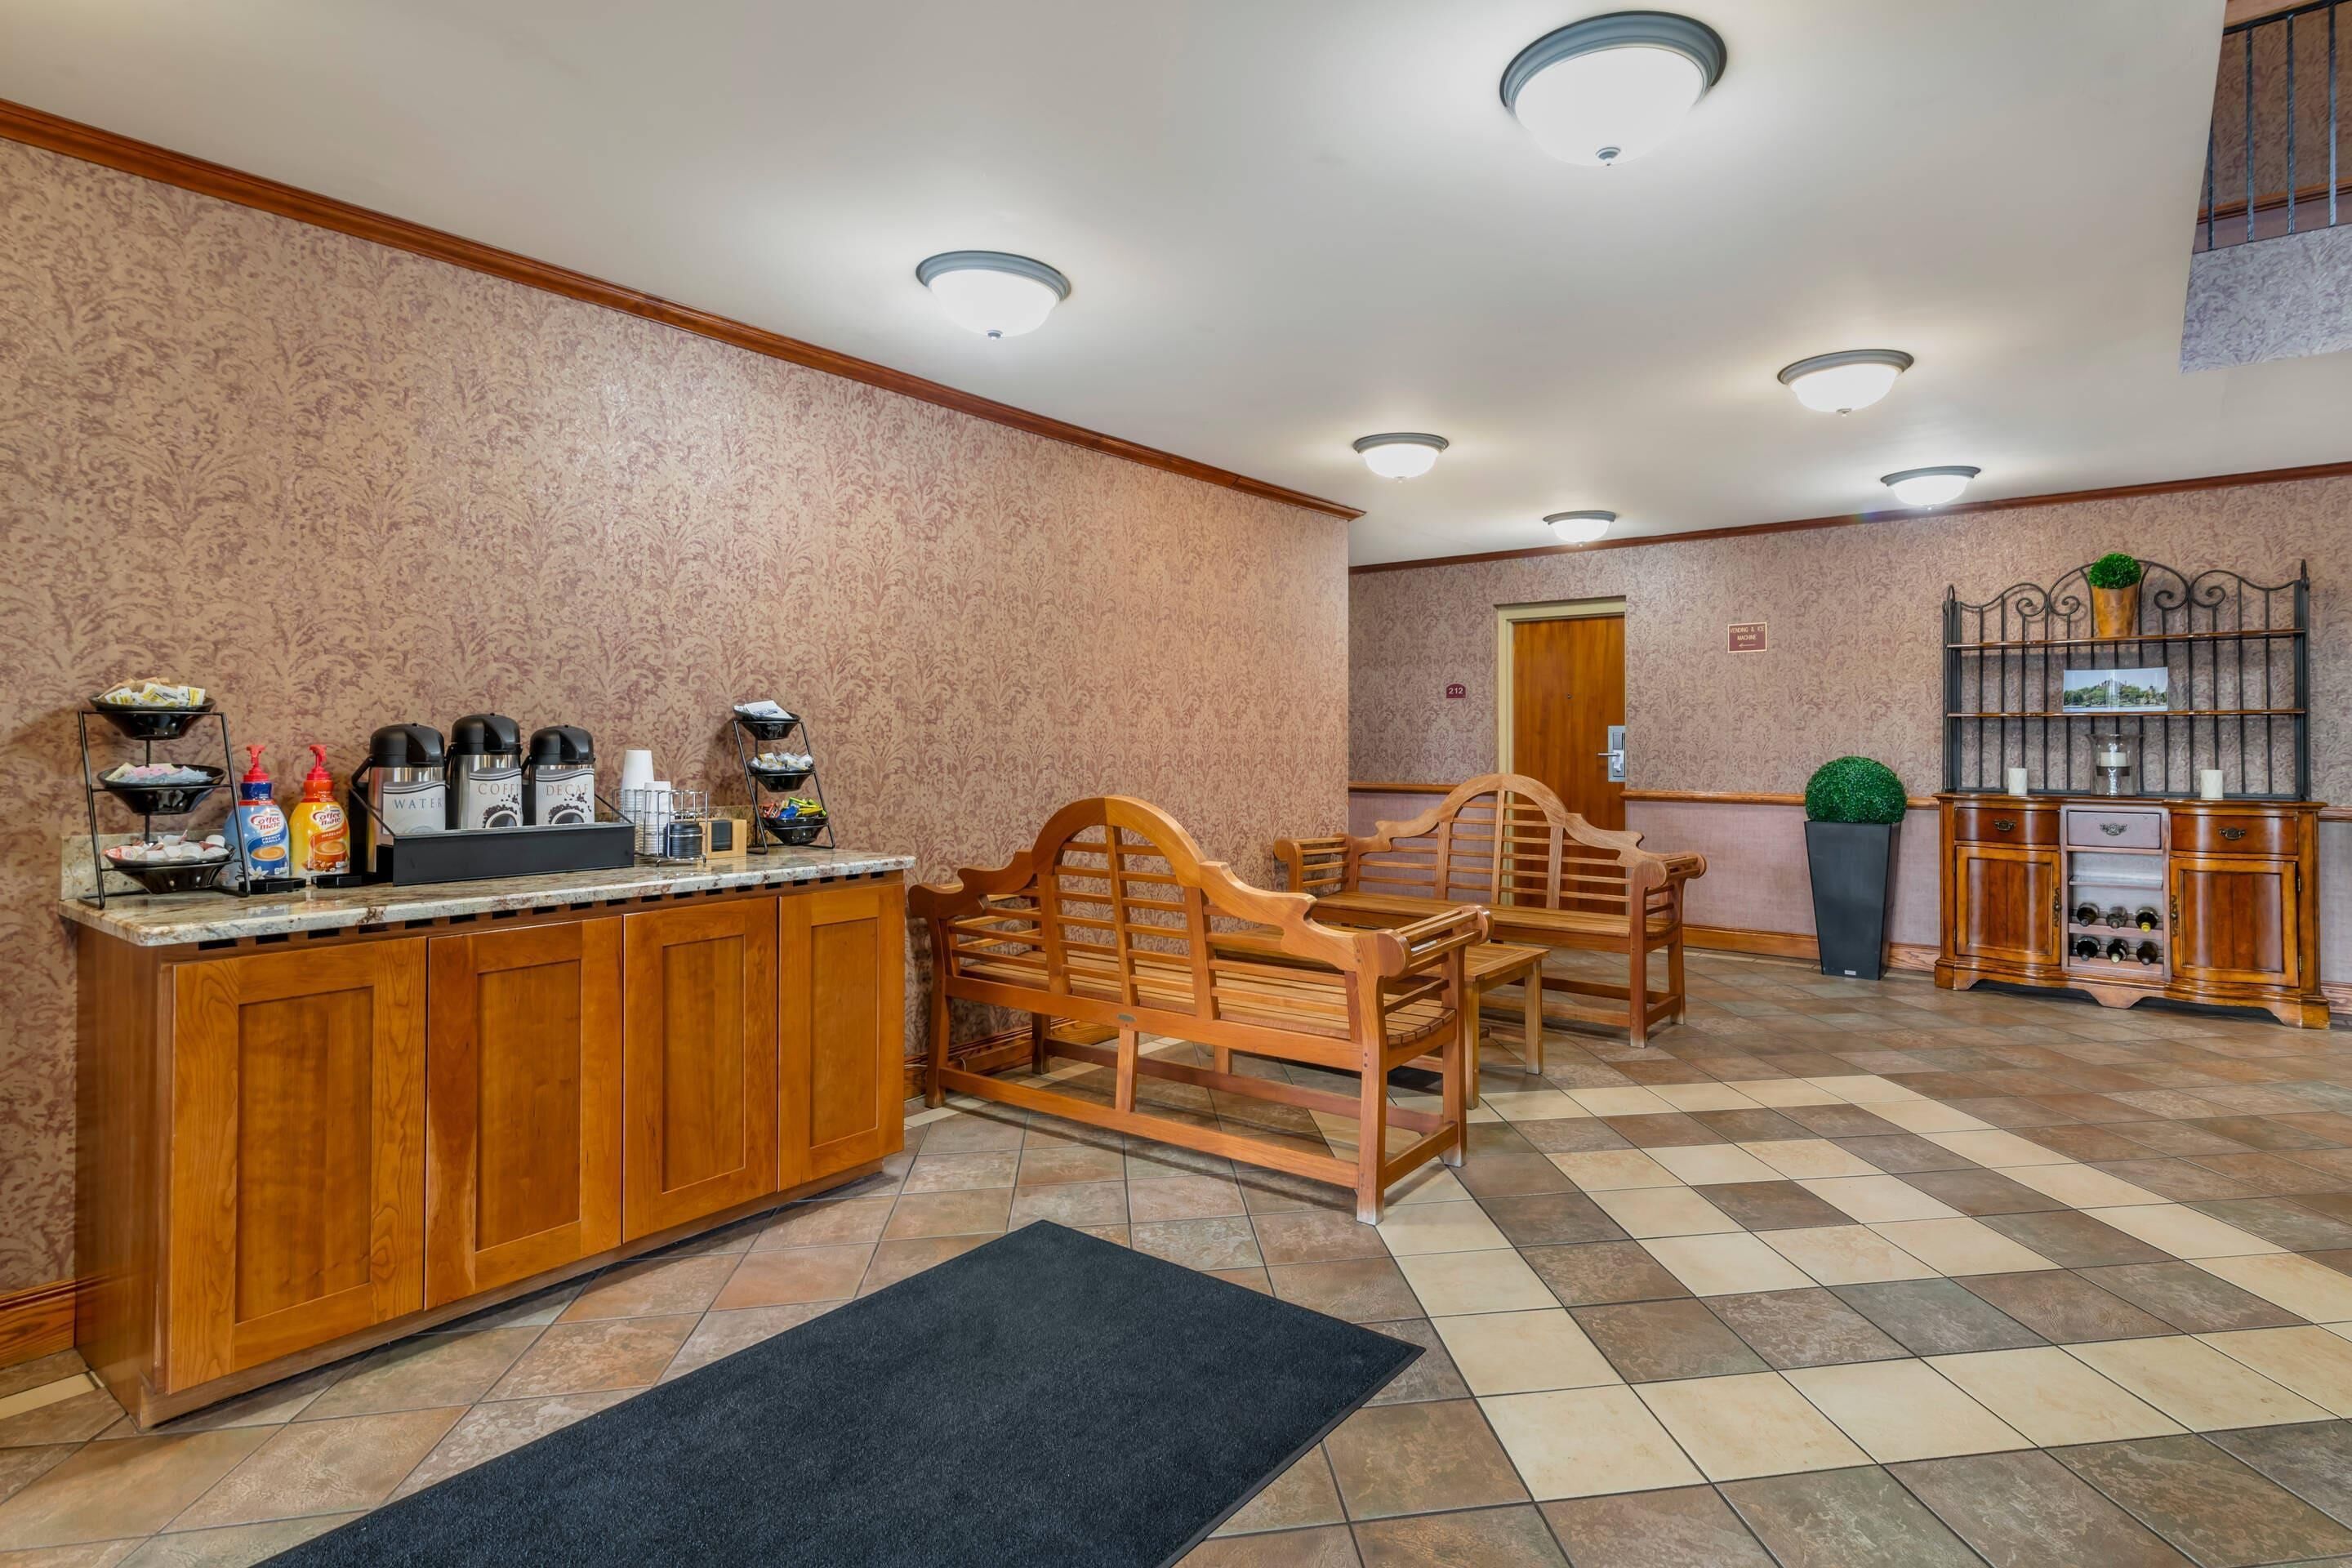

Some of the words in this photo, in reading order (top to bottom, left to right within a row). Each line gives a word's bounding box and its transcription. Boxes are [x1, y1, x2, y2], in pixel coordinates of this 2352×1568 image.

[546, 783, 589, 795] DECAF
[394, 798, 444, 809] WATER
[250, 815, 281, 826] Coffee
[312, 811, 341, 821] Coffee
